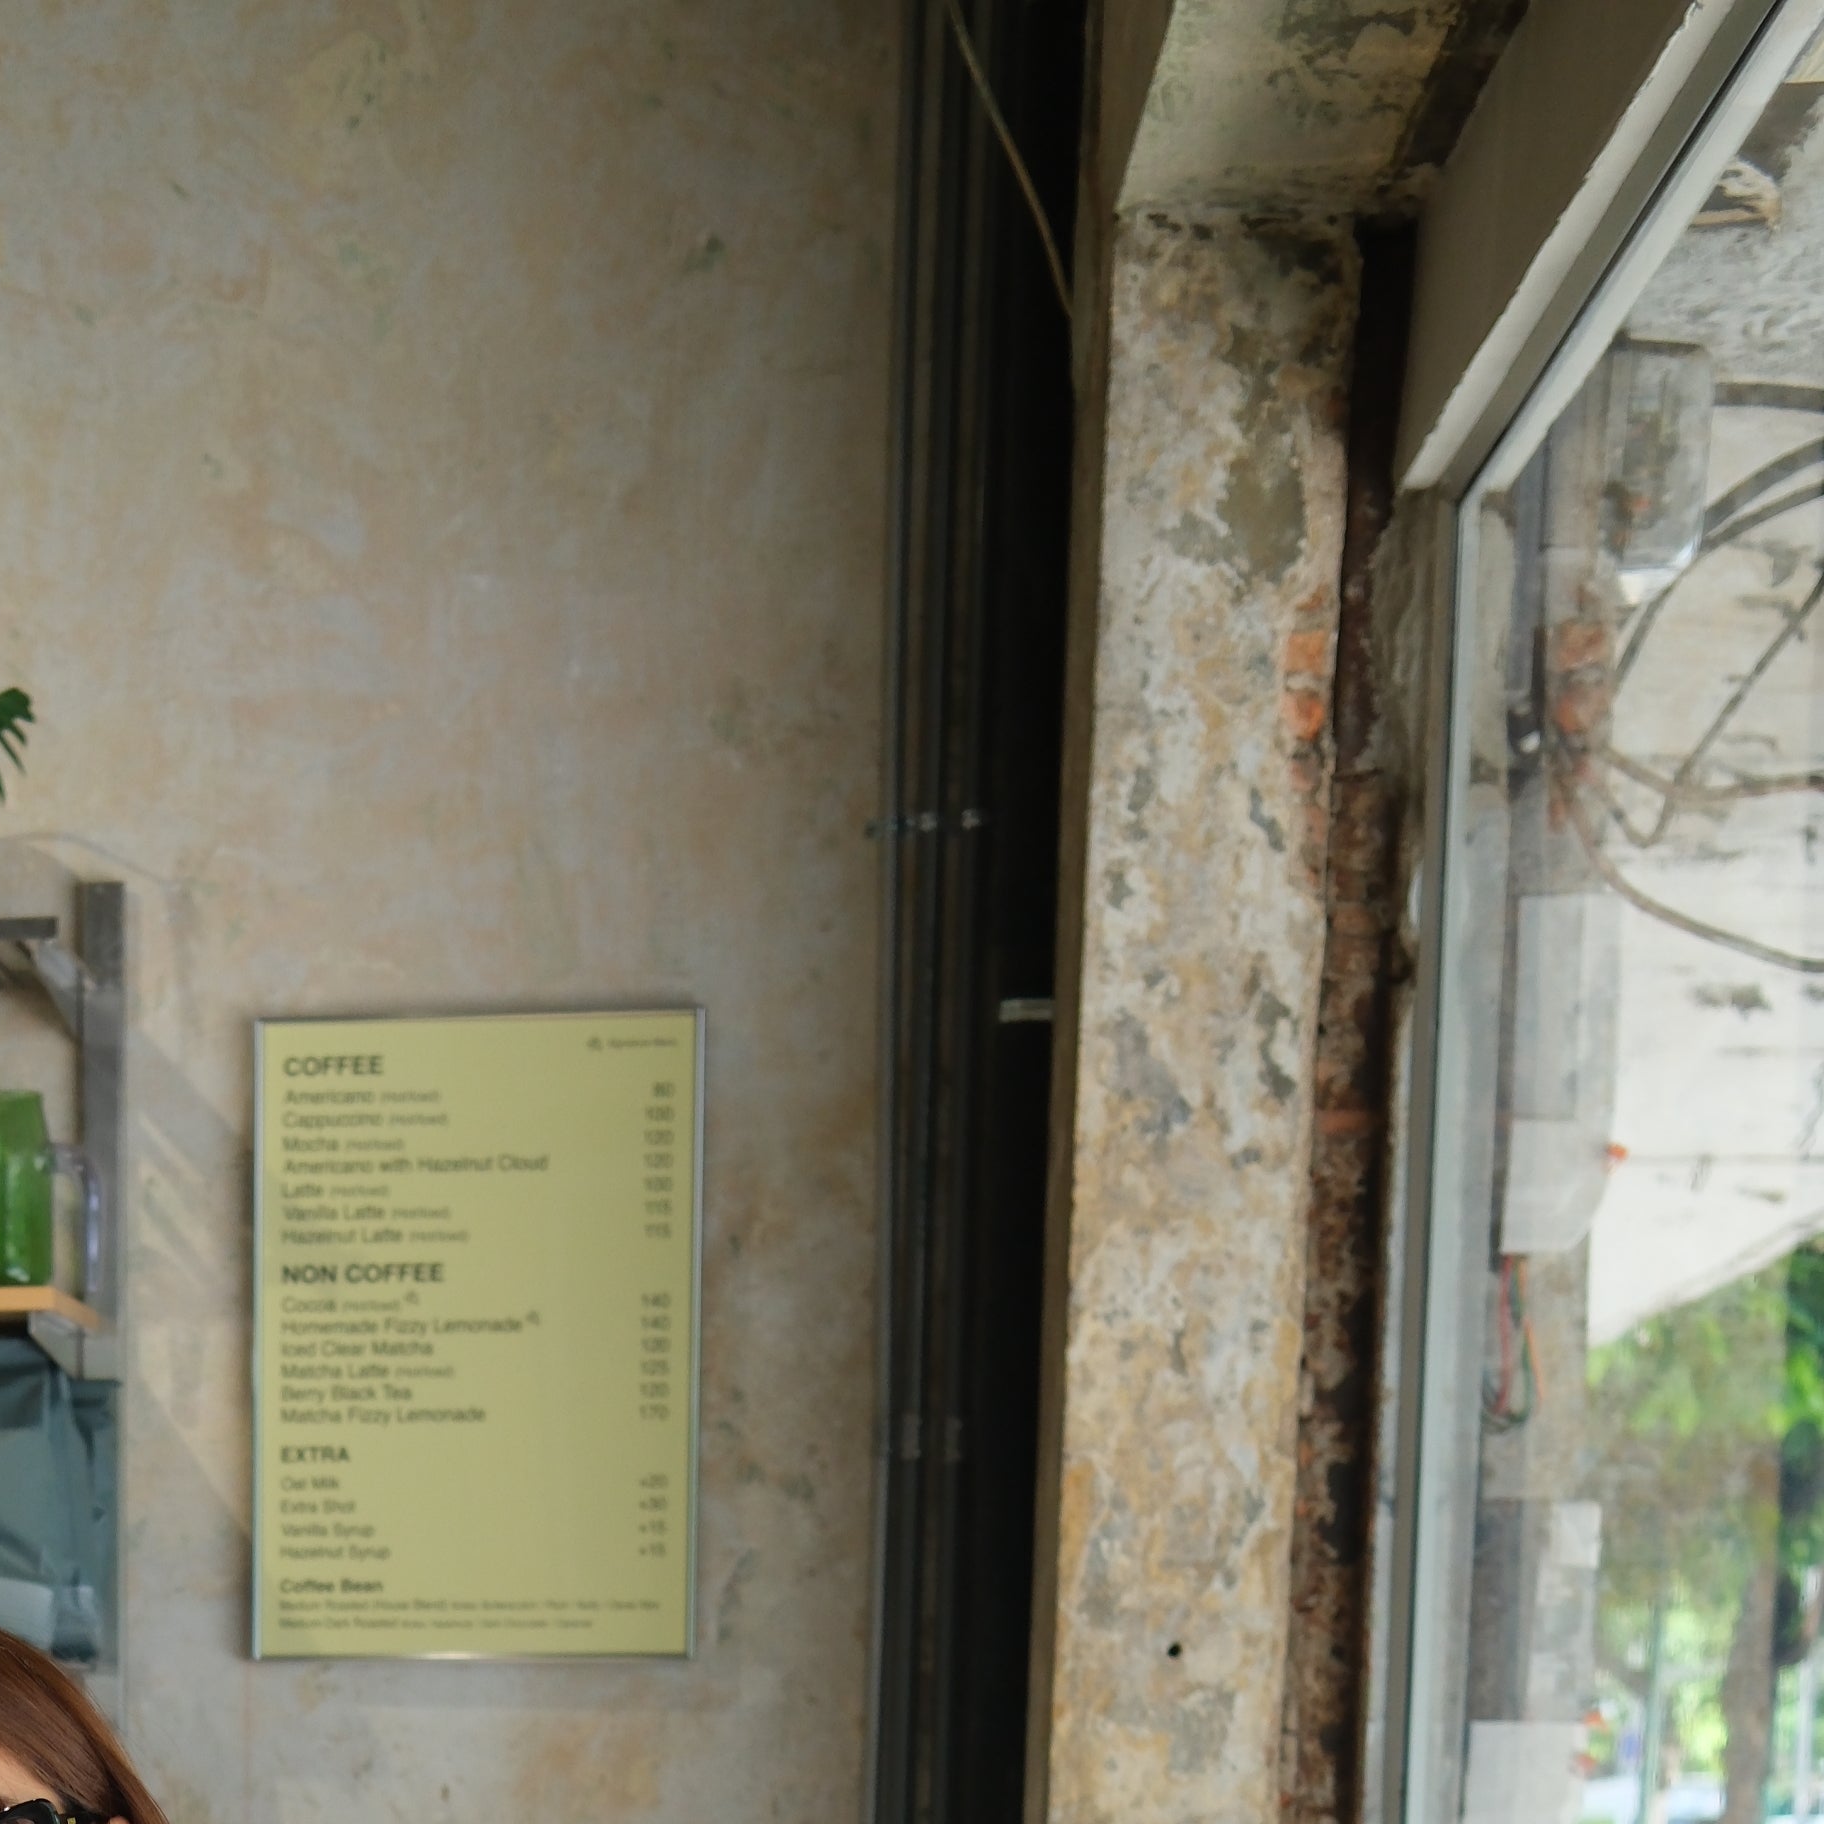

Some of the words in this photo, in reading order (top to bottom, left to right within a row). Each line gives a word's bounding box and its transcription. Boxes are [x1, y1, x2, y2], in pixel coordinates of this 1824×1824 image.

[283, 1055, 383, 1077] COFFEE
[285, 1090, 374, 1105] Americano
[282, 1111, 383, 1129] Cappuccino
[282, 1136, 339, 1152] Mocha
[284, 1158, 374, 1174] Americano
[379, 1157, 412, 1173] with
[416, 1154, 493, 1172] Hazelnut
[497, 1153, 549, 1172] Cloud
[281, 1183, 324, 1198] Latte
[283, 1204, 338, 1221] Vanilla
[343, 1204, 386, 1220] Latte
[281, 1229, 356, 1245] Hazelnut
[362, 1228, 403, 1243] Latte
[281, 1264, 337, 1284] NON
[344, 1262, 445, 1283] COFFEE
[281, 1296, 337, 1313] Cocoa
[281, 1319, 378, 1335] Homemade
[383, 1317, 427, 1336] Fizzy
[433, 1316, 523, 1335] Lemonade
[281, 1341, 317, 1357] Iced
[321, 1340, 365, 1357] Clear
[370, 1340, 434, 1356] Matcha
[280, 1364, 343, 1379] Matcha
[348, 1363, 390, 1379] Latte
[281, 1385, 324, 1403] Berry
[330, 1385, 376, 1401] Black
[383, 1383, 413, 1400] Tea
[280, 1407, 342, 1423] Matcha
[348, 1406, 391, 1426] Fizzy
[396, 1404, 486, 1423] Lemonade
[280, 1446, 350, 1463] EXTRA
[311, 1476, 339, 1490] Milk
[280, 1500, 318, 1514] Extra
[323, 1499, 357, 1514] Shot
[281, 1523, 328, 1537] Vanilla
[333, 1522, 375, 1539] Syrup
[280, 1547, 343, 1560] Hazelnut
[348, 1545, 391, 1562] Syrup
[280, 1579, 335, 1593] Coffee
[340, 1579, 384, 1593] Bean
